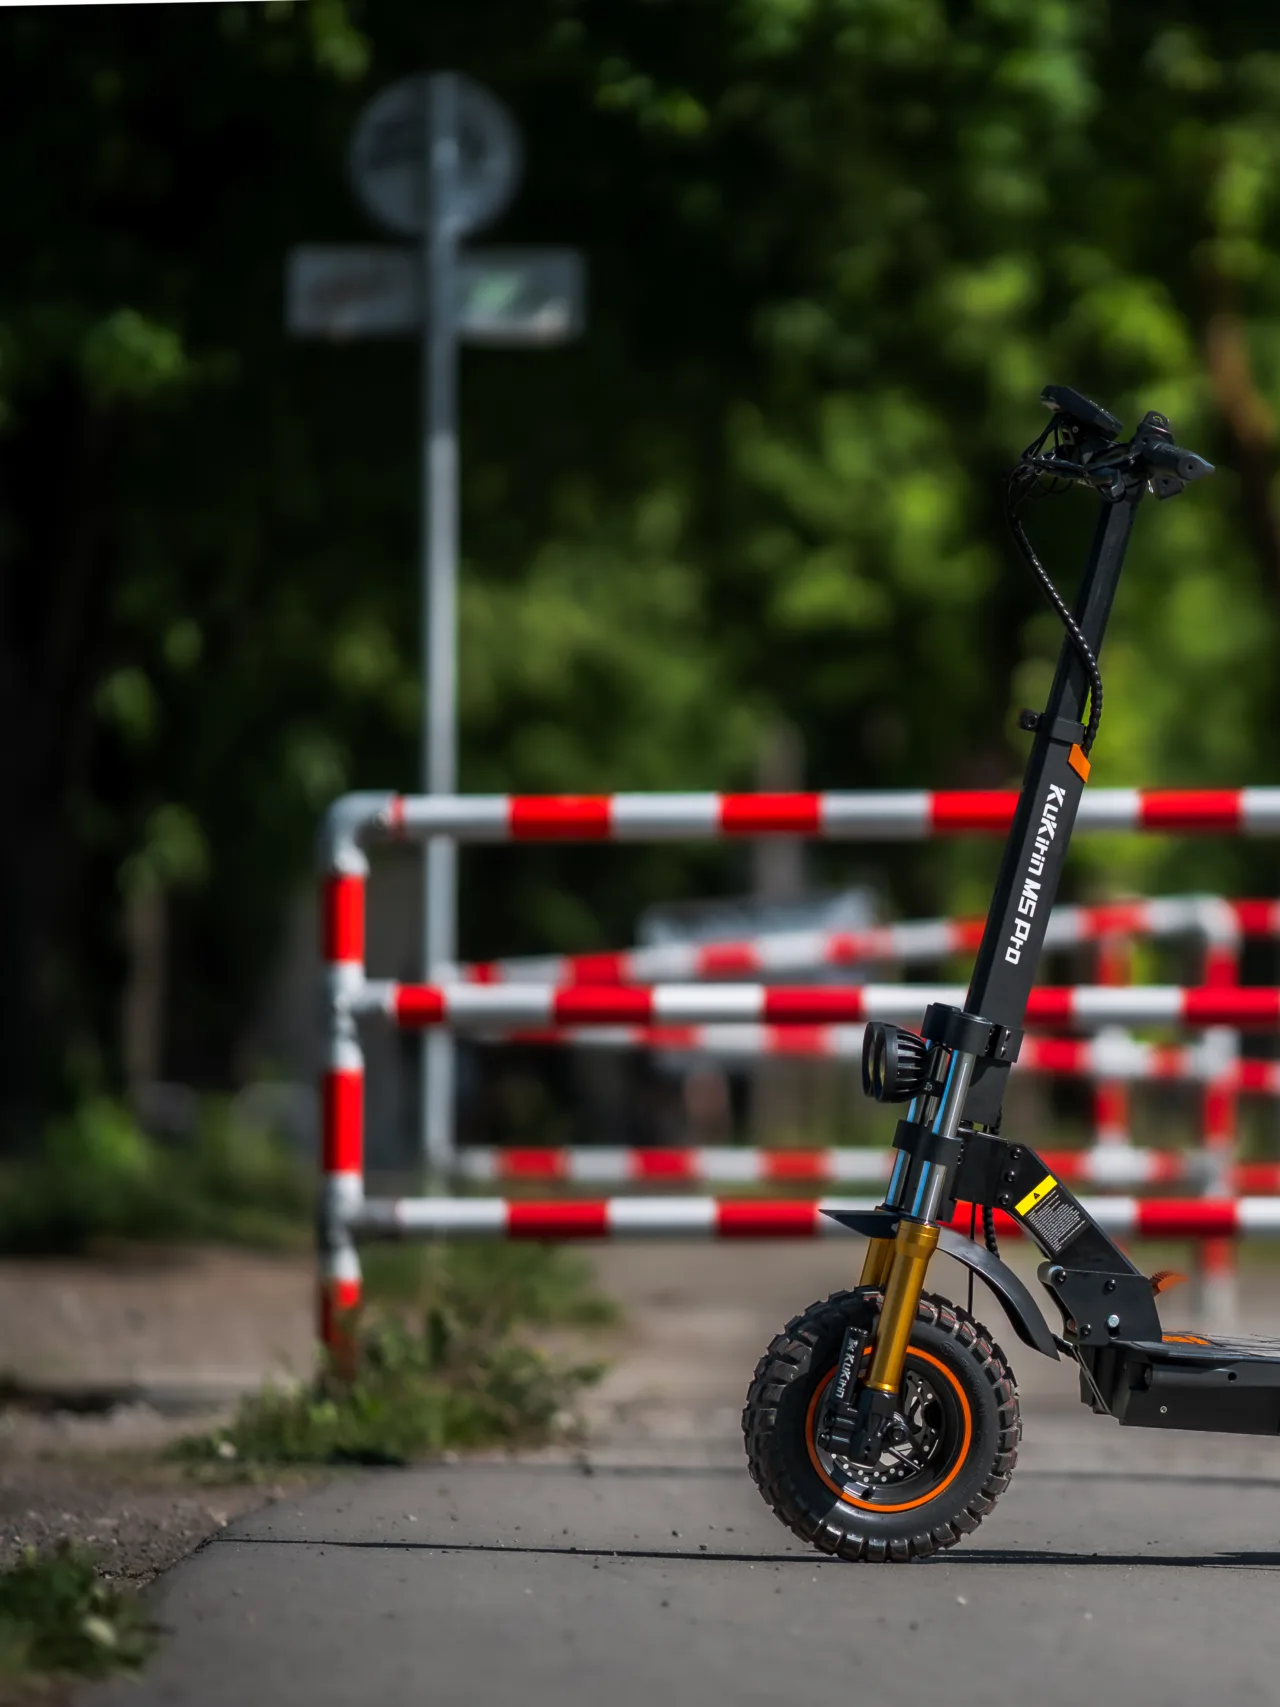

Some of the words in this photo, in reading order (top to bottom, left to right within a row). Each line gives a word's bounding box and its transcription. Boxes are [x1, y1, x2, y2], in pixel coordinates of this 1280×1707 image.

[1028, 783, 1066, 877] KuKirin
[1005, 918, 1031, 965] Pro
[836, 1353, 855, 1398] KuKirin
